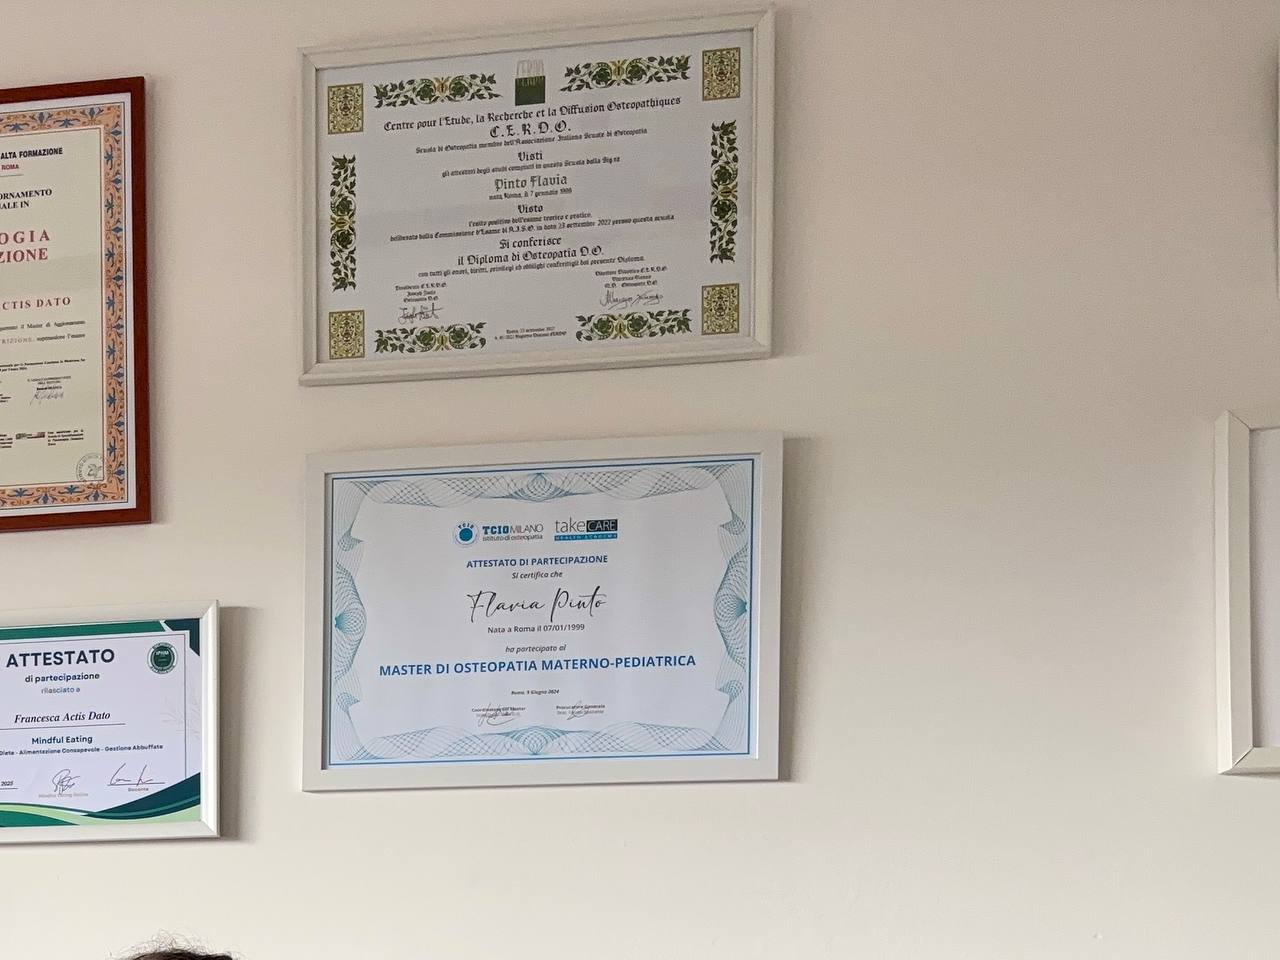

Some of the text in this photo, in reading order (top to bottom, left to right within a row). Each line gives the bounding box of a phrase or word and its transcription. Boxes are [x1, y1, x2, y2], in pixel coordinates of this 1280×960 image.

[384, 121, 414, 132] Centre
[416, 120, 437, 130] pour
[476, 114, 485, 123] la
[487, 110, 533, 122] Recherche
[536, 108, 545, 117] et
[548, 107, 557, 117] la
[560, 103, 605, 116] Diffusion
[607, 97, 681, 112] Osteopathiques
[0, 151, 17, 160] ALTA
[18, 148, 63, 158] FORMAZIONE
[518, 151, 543, 161] Visti
[494, 174, 568, 191] Pinto Flavia
[20, 201, 30, 210] IN
[518, 204, 544, 214] Visto
[499, 236, 562, 249] Si conferisce
[457, 255, 464, 266] il
[466, 253, 509, 266] Diploma
[511, 251, 520, 261] di
[522, 247, 577, 262] Osteopatia
[36, 296, 71, 308] DATO
[466, 555, 608, 568] ATTESTATO DI PARTECIPAZIONE
[520, 571, 549, 580] certifica
[550, 570, 563, 578] che
[467, 585, 608, 623] Flavia Pinto
[487, 626, 506, 634] Nata
[513, 625, 535, 633] Roma
[536, 624, 542, 632] il
[543, 623, 585, 632] 07/01/1999
[516, 645, 558, 654] partecipato
[6, 648, 115, 668] ATTESTATO
[379, 655, 697, 677] MASTER DI OSTEOPATIA MATERNO-PEDIATRICA
[24, 671, 100, 684] di partecipazione
[41, 685, 74, 694] rilasciato
[14, 710, 111, 724] Francesca Actis Dato
[31, 735, 93, 745] Mindful Eating
[62, 746, 100, 754] Consapevole
